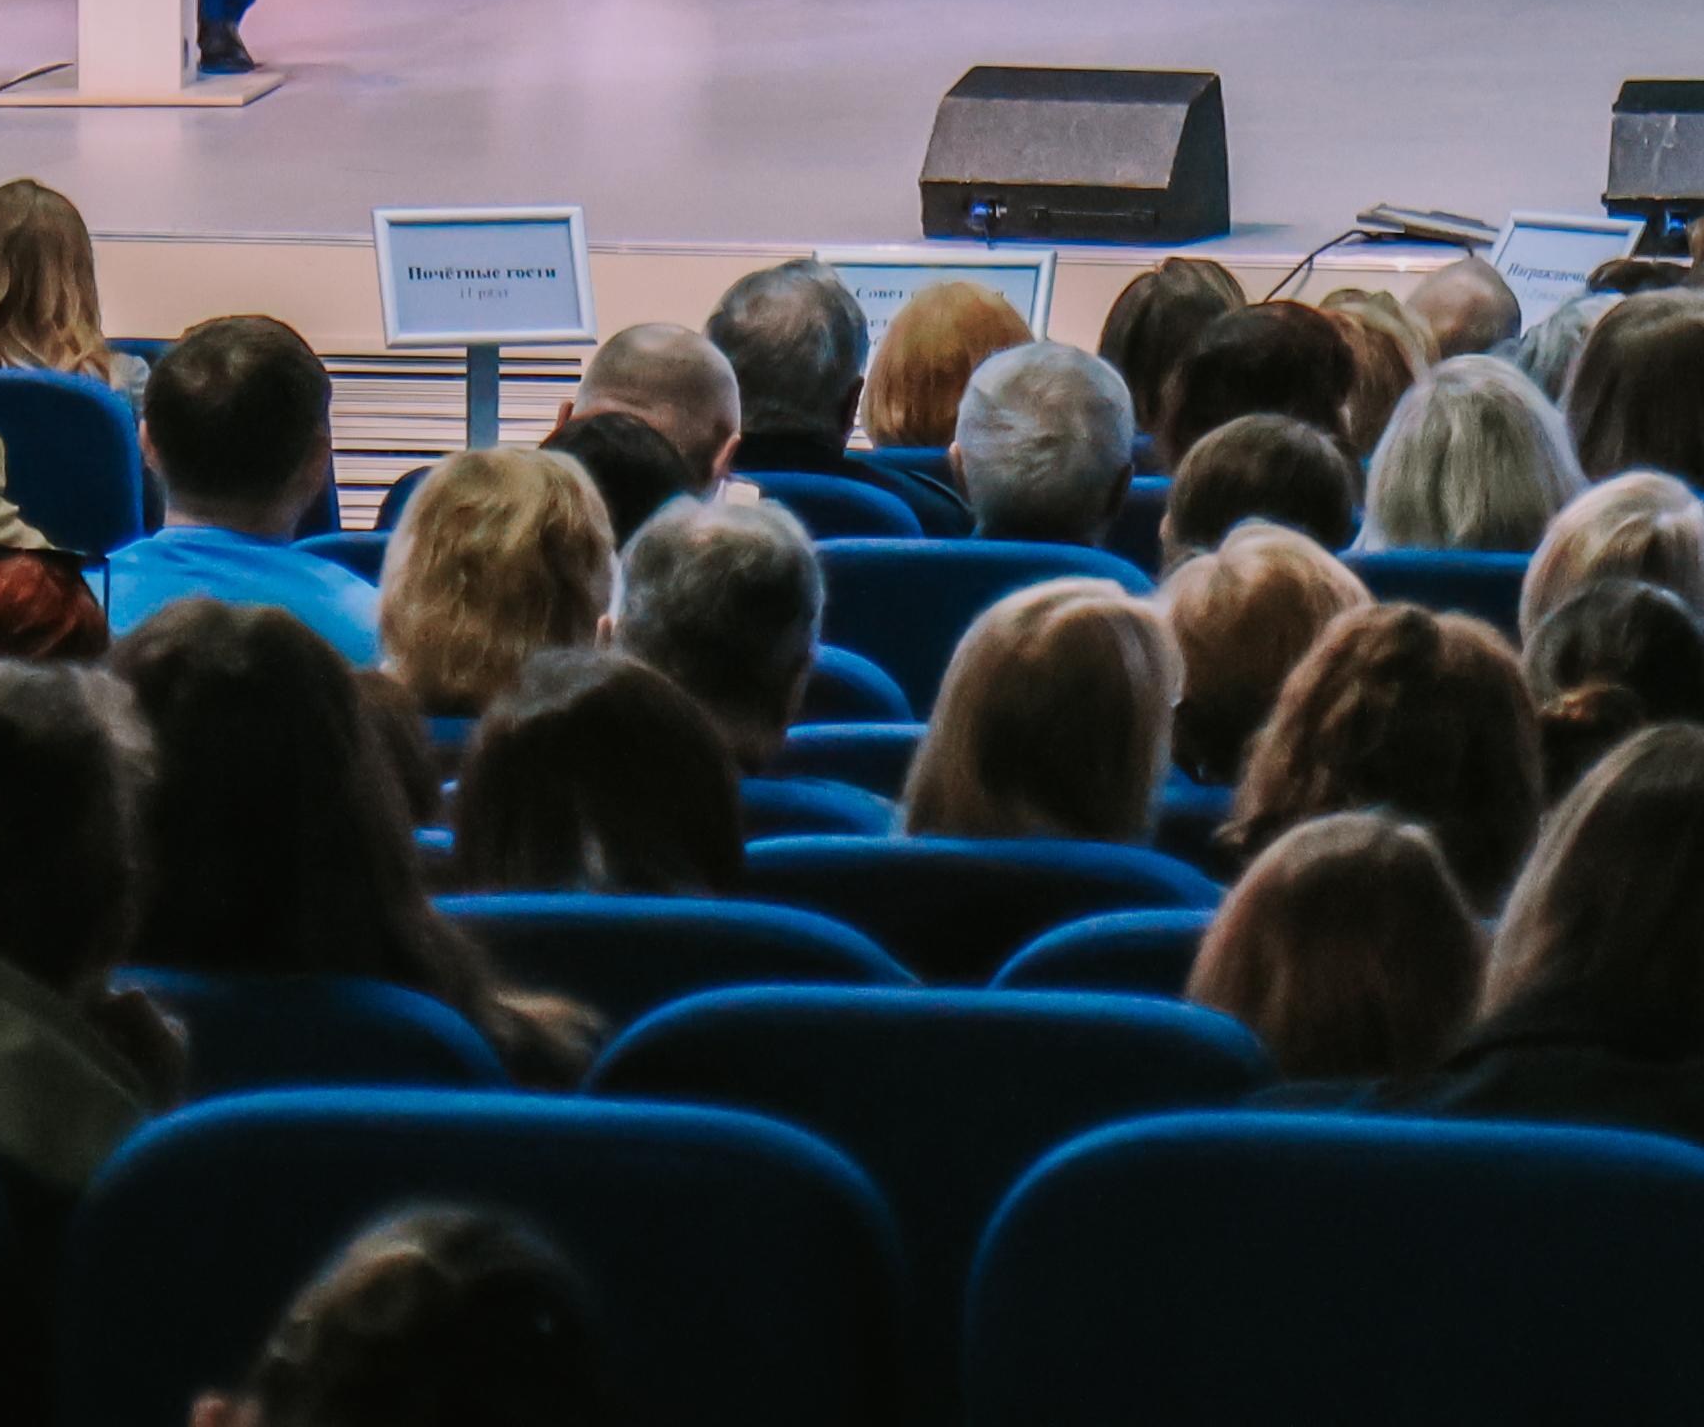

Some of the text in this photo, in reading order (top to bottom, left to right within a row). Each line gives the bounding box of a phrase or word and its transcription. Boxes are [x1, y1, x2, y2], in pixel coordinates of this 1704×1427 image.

[407, 266, 557, 281] Почётные гости
[856, 288, 903, 299] Совет
